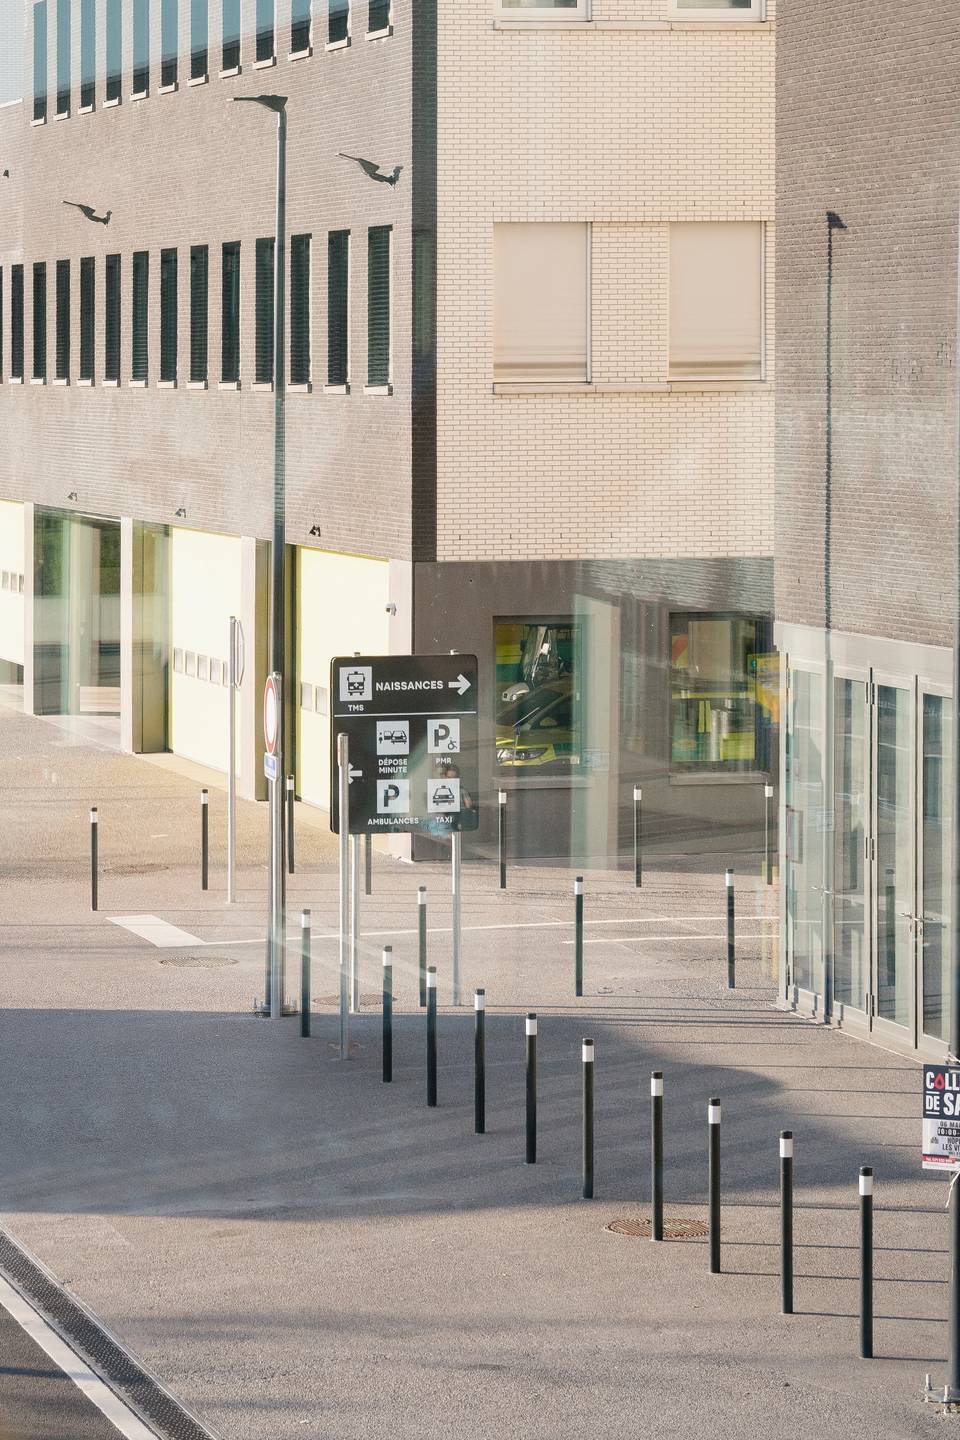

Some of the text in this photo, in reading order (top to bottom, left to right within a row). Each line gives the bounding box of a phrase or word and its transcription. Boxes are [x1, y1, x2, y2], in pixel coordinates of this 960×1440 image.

[375, 680, 444, 691] NAISSANCES
[378, 758, 408, 766] DÉPOSE
[435, 757, 452, 765] PMR
[378, 766, 408, 774] MINUTE
[367, 817, 419, 825] AMBULANCES
[435, 816, 453, 824] TAXI
[925, 1094, 940, 1111] DE
